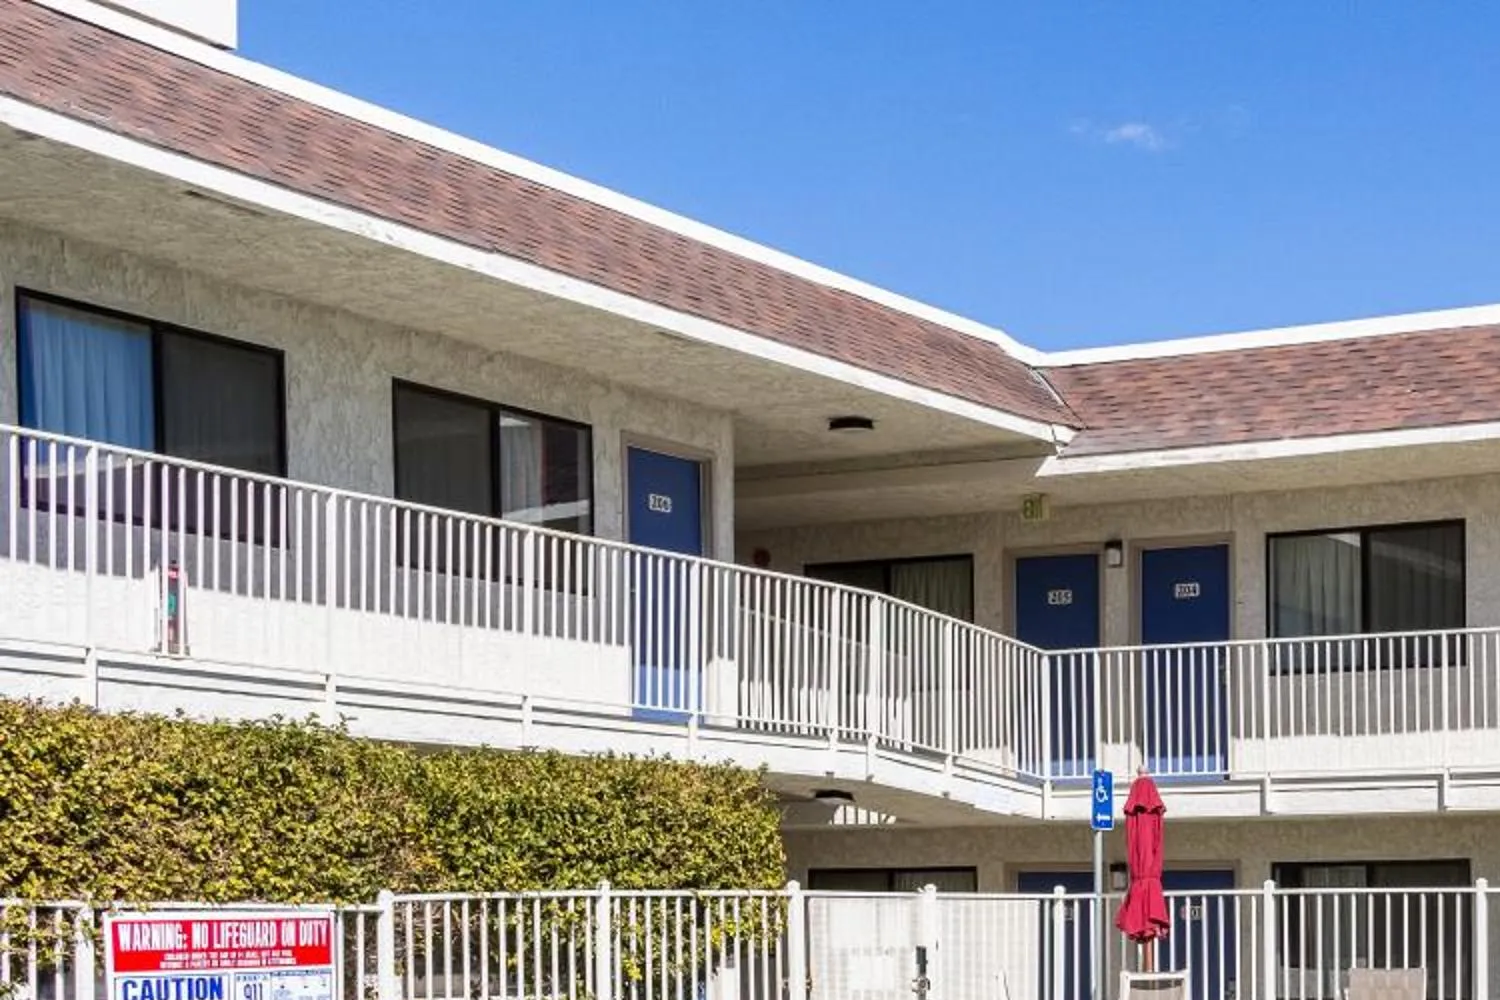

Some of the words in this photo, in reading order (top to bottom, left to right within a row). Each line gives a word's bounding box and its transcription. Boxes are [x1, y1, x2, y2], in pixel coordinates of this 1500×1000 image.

[117, 922, 188, 951] WARNING:
[191, 921, 209, 949] NO
[212, 921, 277, 949] LIFEGUARD
[280, 921, 297, 947] ON
[300, 920, 328, 947] DUTY
